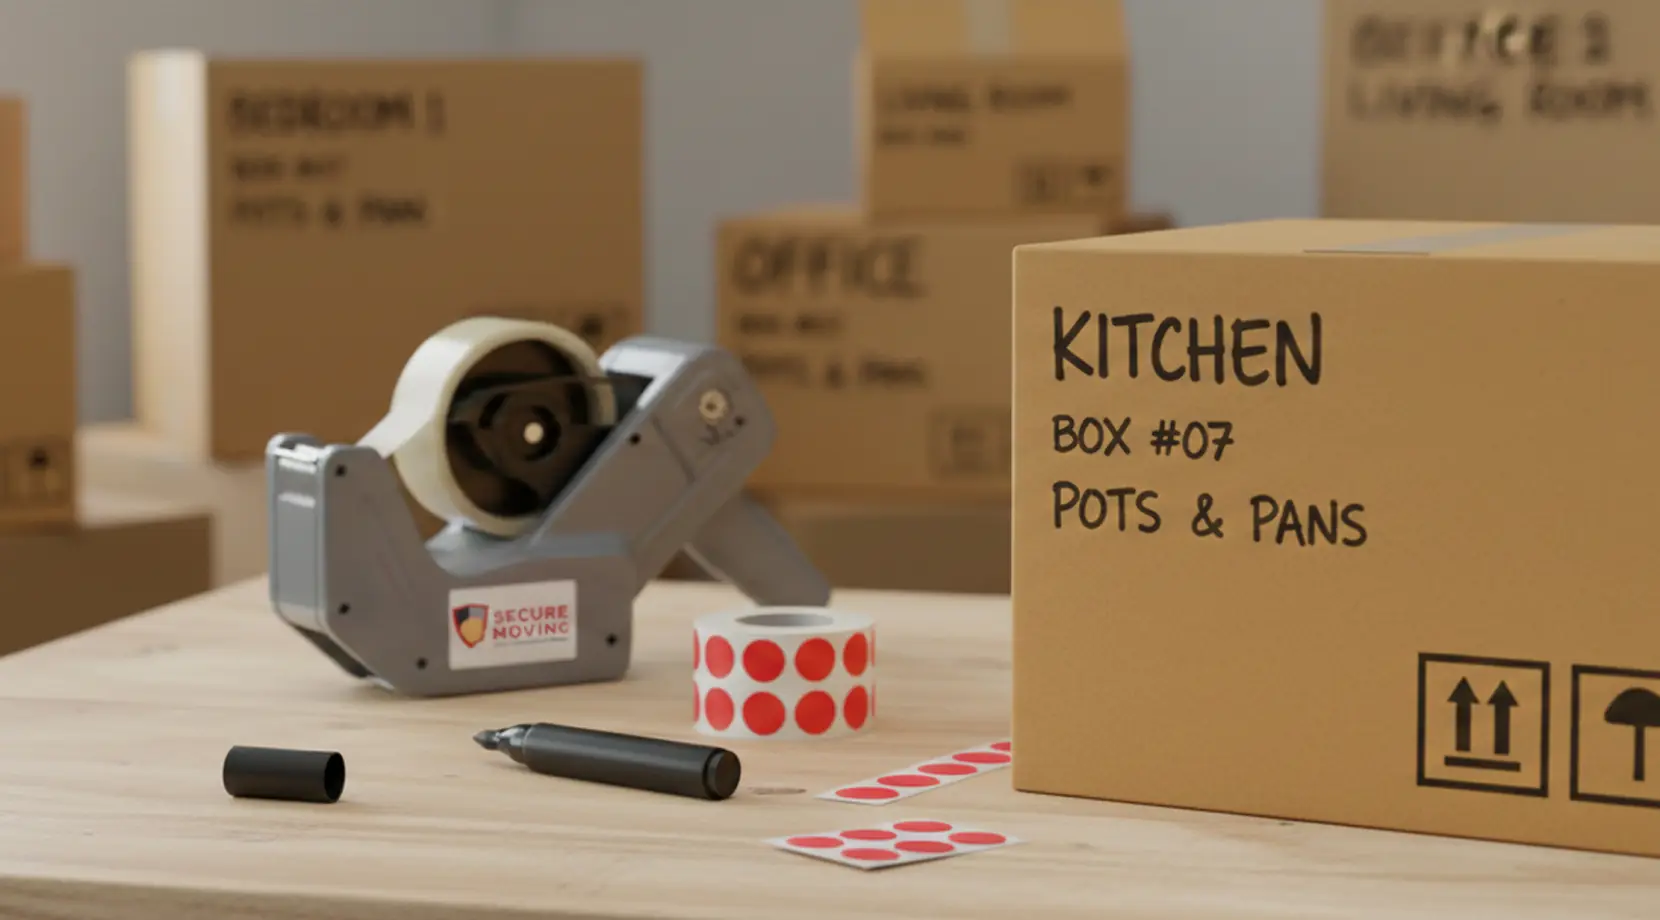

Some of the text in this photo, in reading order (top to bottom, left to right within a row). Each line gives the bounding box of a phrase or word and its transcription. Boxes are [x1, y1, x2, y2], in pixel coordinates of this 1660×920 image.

[734, 236, 928, 298] OFFICE
[1053, 306, 1322, 387] KITCHEN
[1052, 414, 1235, 462] BOX #07
[1052, 481, 1368, 547] POTS & PANS
[493, 604, 569, 624] SECURE
